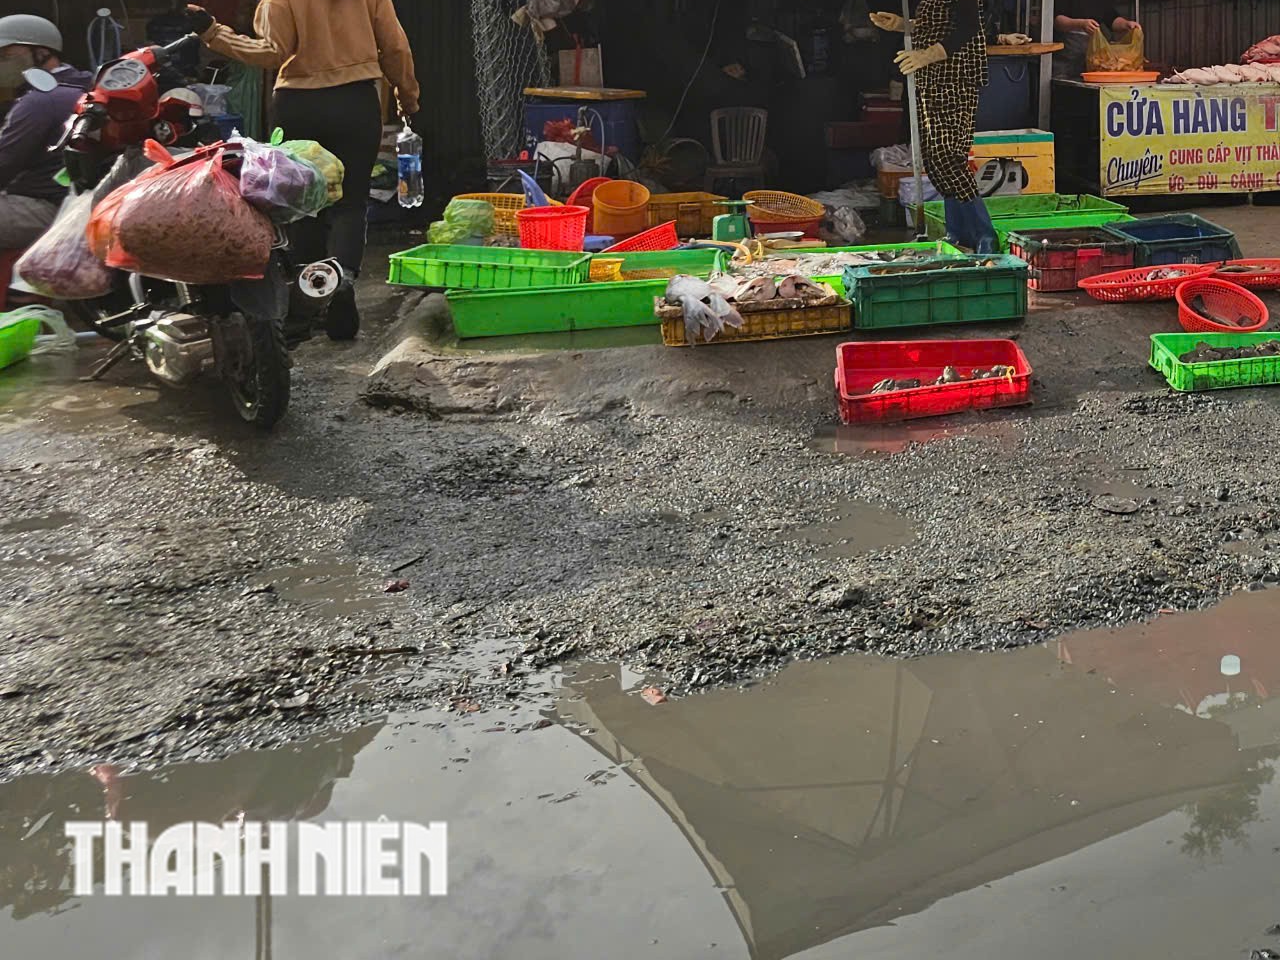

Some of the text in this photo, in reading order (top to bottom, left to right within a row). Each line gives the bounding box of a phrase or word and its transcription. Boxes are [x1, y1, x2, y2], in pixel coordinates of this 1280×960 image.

[1106, 90, 1164, 137] CỬA
[1173, 92, 1247, 135] HÀNG
[1106, 148, 1164, 190] Chuyên:
[1169, 148, 1203, 165] CUNG
[1207, 141, 1231, 163] CẤP
[1234, 146, 1252, 165] VỊT
